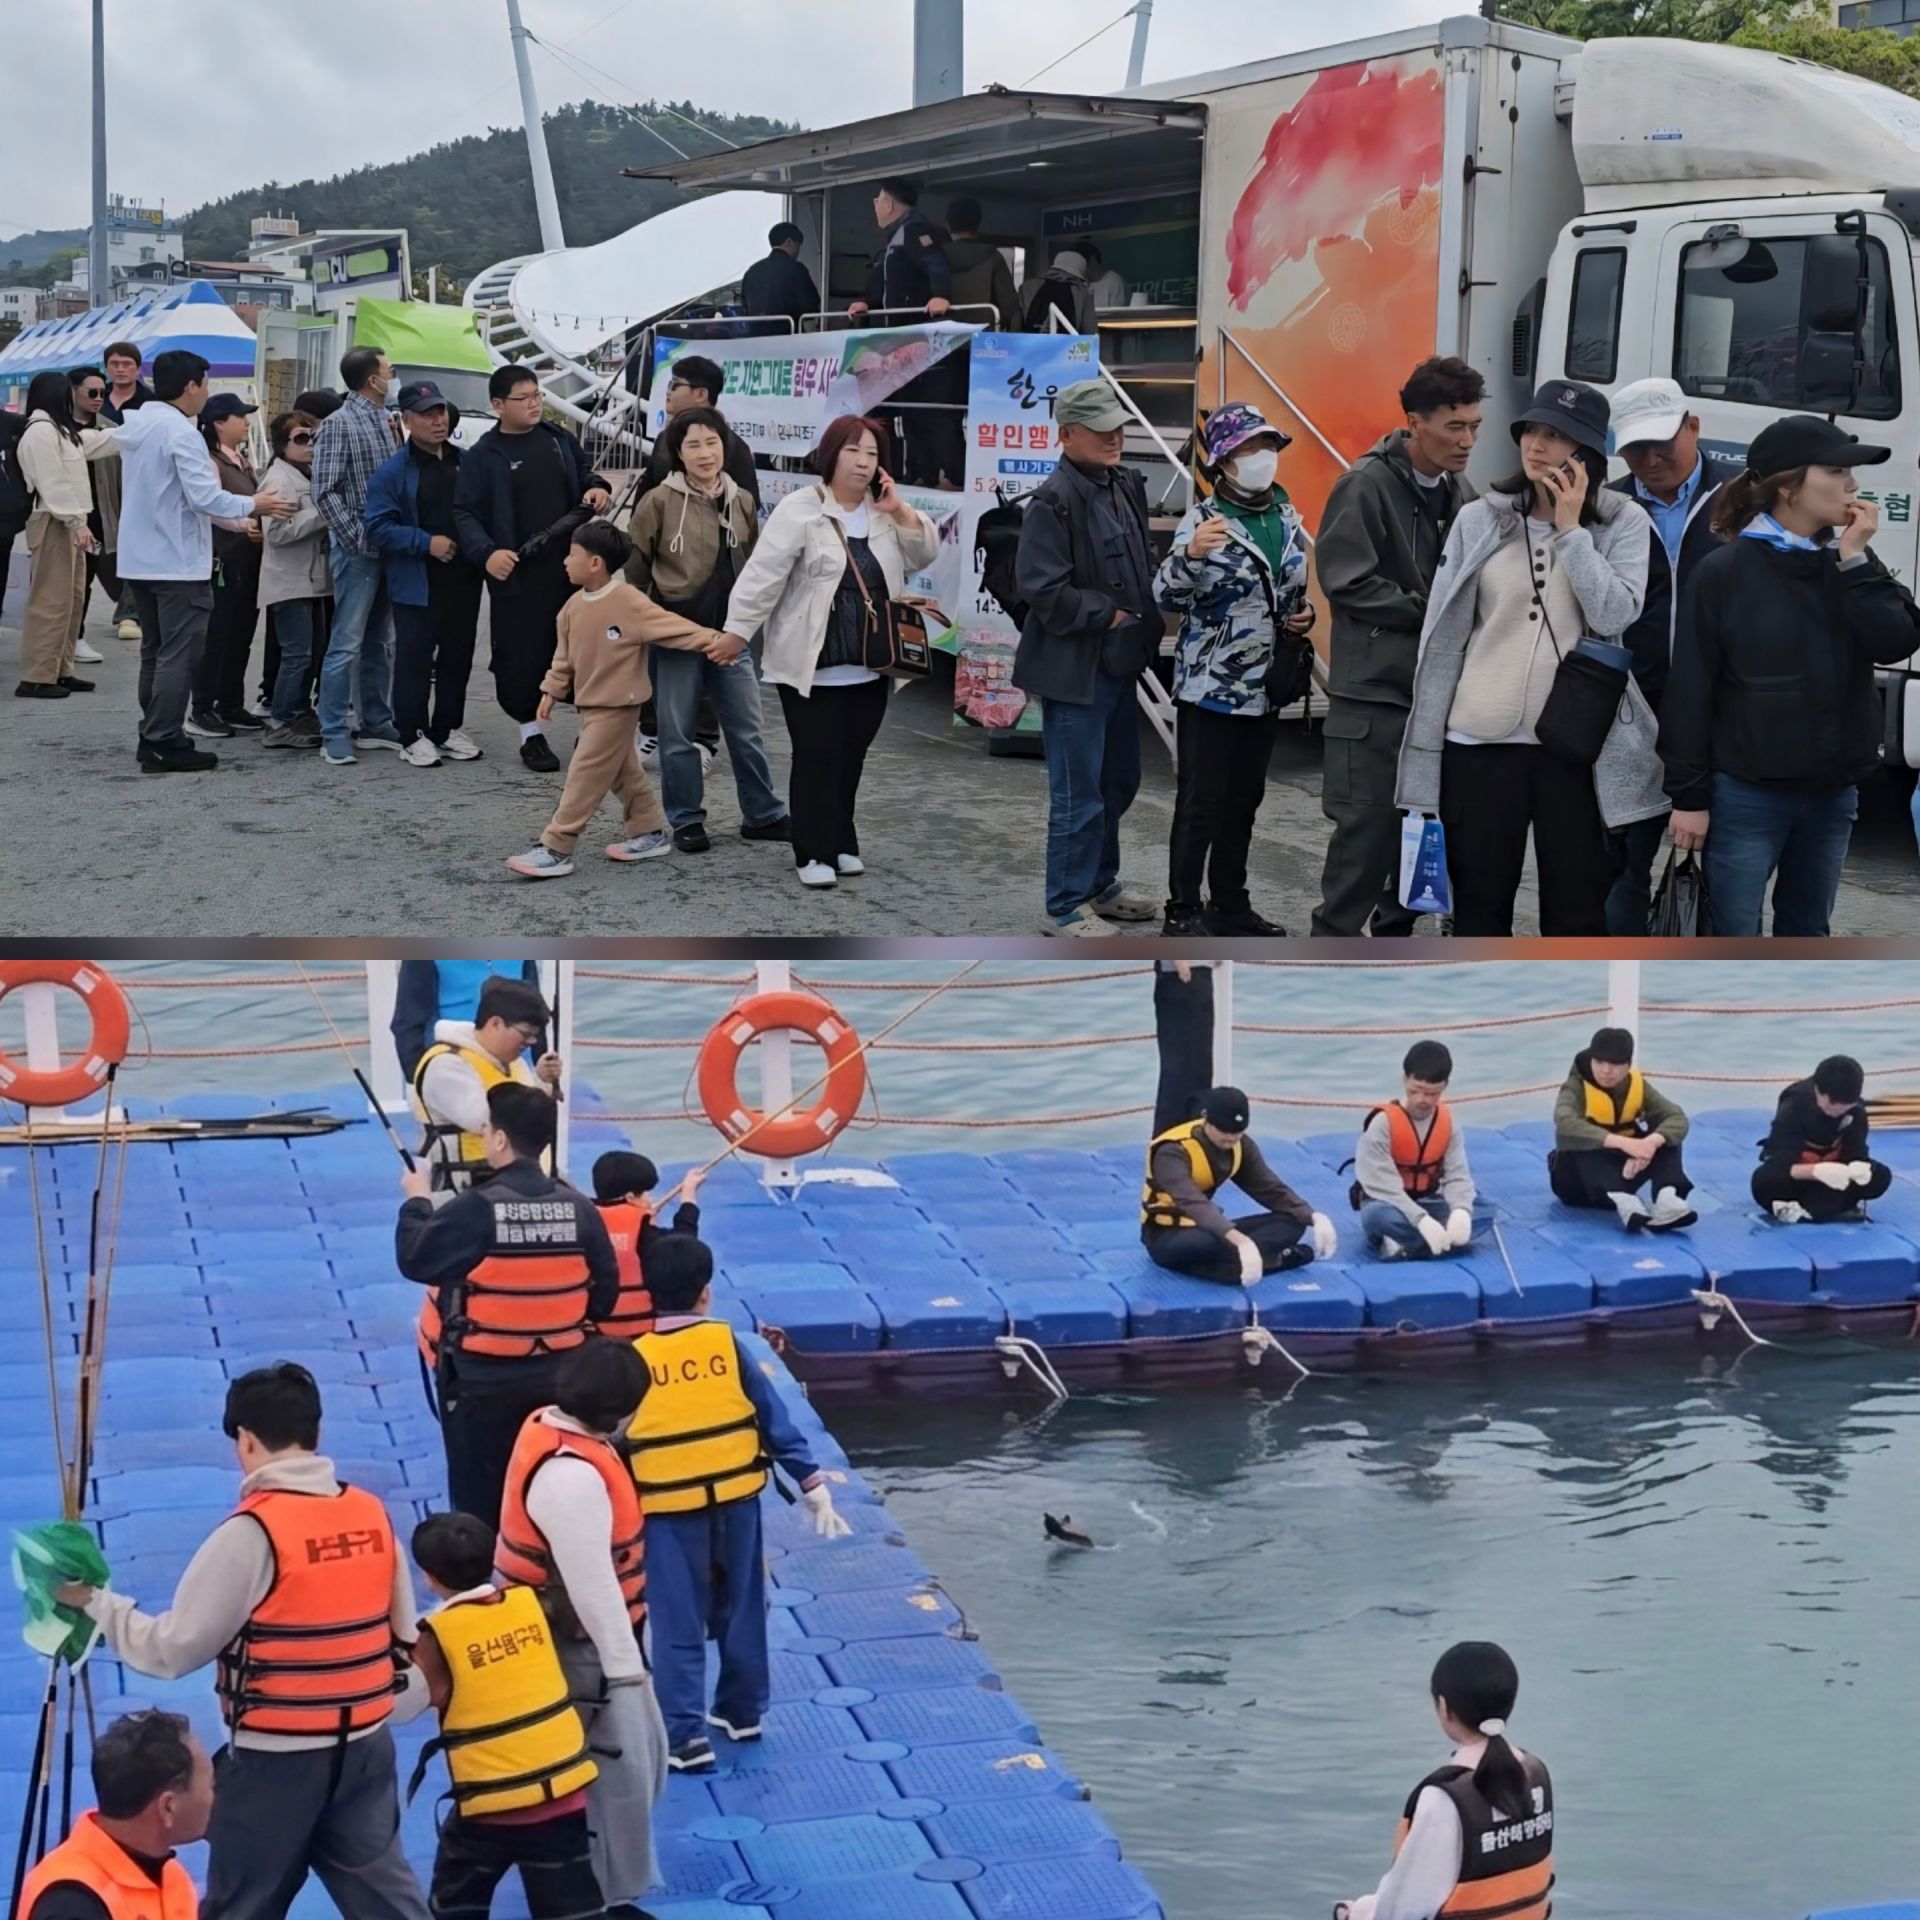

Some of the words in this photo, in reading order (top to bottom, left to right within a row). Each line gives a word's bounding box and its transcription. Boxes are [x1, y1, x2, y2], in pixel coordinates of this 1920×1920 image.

[1063, 213, 1093, 229] NH
[794, 358, 818, 398] 한우
[977, 422, 1062, 449] 할인행
[1709, 450, 1748, 463] Truc
[652, 1355, 727, 1387] U.C.G
